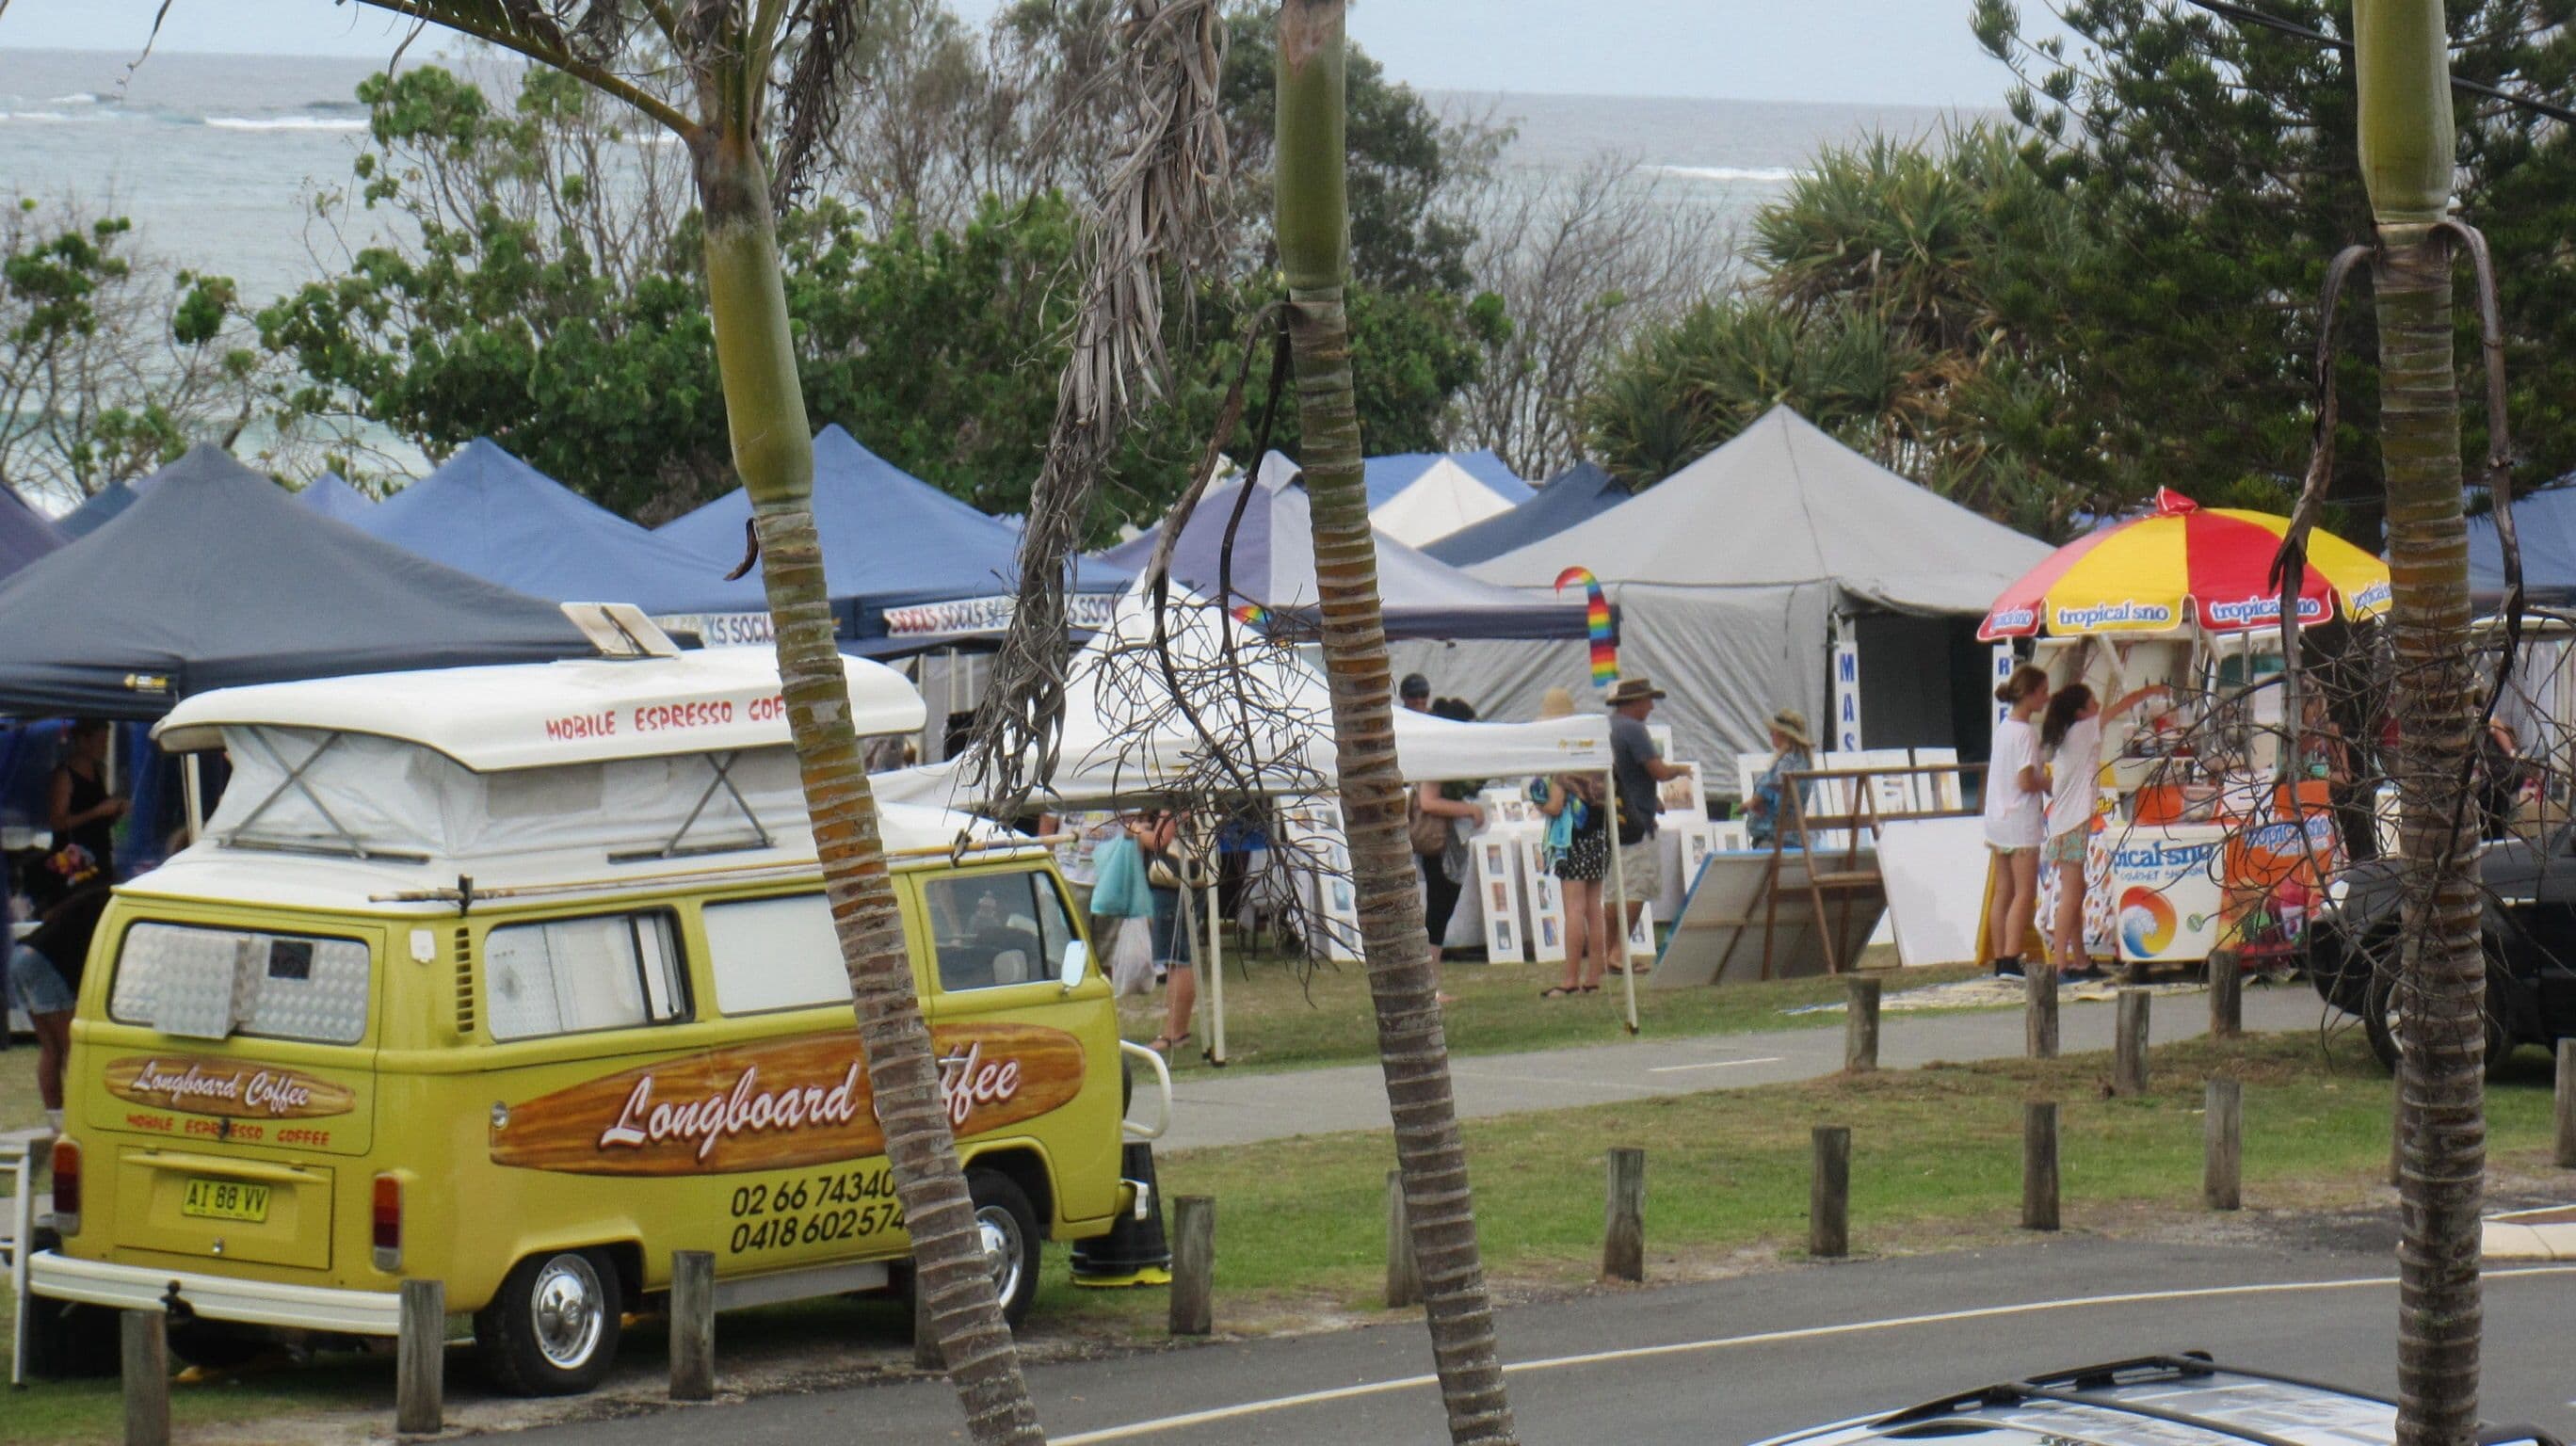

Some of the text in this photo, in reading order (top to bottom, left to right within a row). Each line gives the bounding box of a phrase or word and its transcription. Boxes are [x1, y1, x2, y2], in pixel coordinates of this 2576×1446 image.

[2059, 602, 2169, 627] tropical sno
[2212, 599, 2282, 622] tropica
[731, 616, 777, 644] SOCK
[545, 695, 784, 741] MOBILE ESPRESSO COF
[131, 1061, 310, 1112] Longboard Coffee
[599, 1040, 1019, 1162] Longboard ffee
[277, 1130, 330, 1146] COFFEE
[187, 1183, 209, 1207] AI
[245, 1188, 267, 1213] VV
[731, 1186, 765, 1217] 02
[773, 1180, 808, 1212] 66
[731, 1203, 905, 1253] 0418 602574
